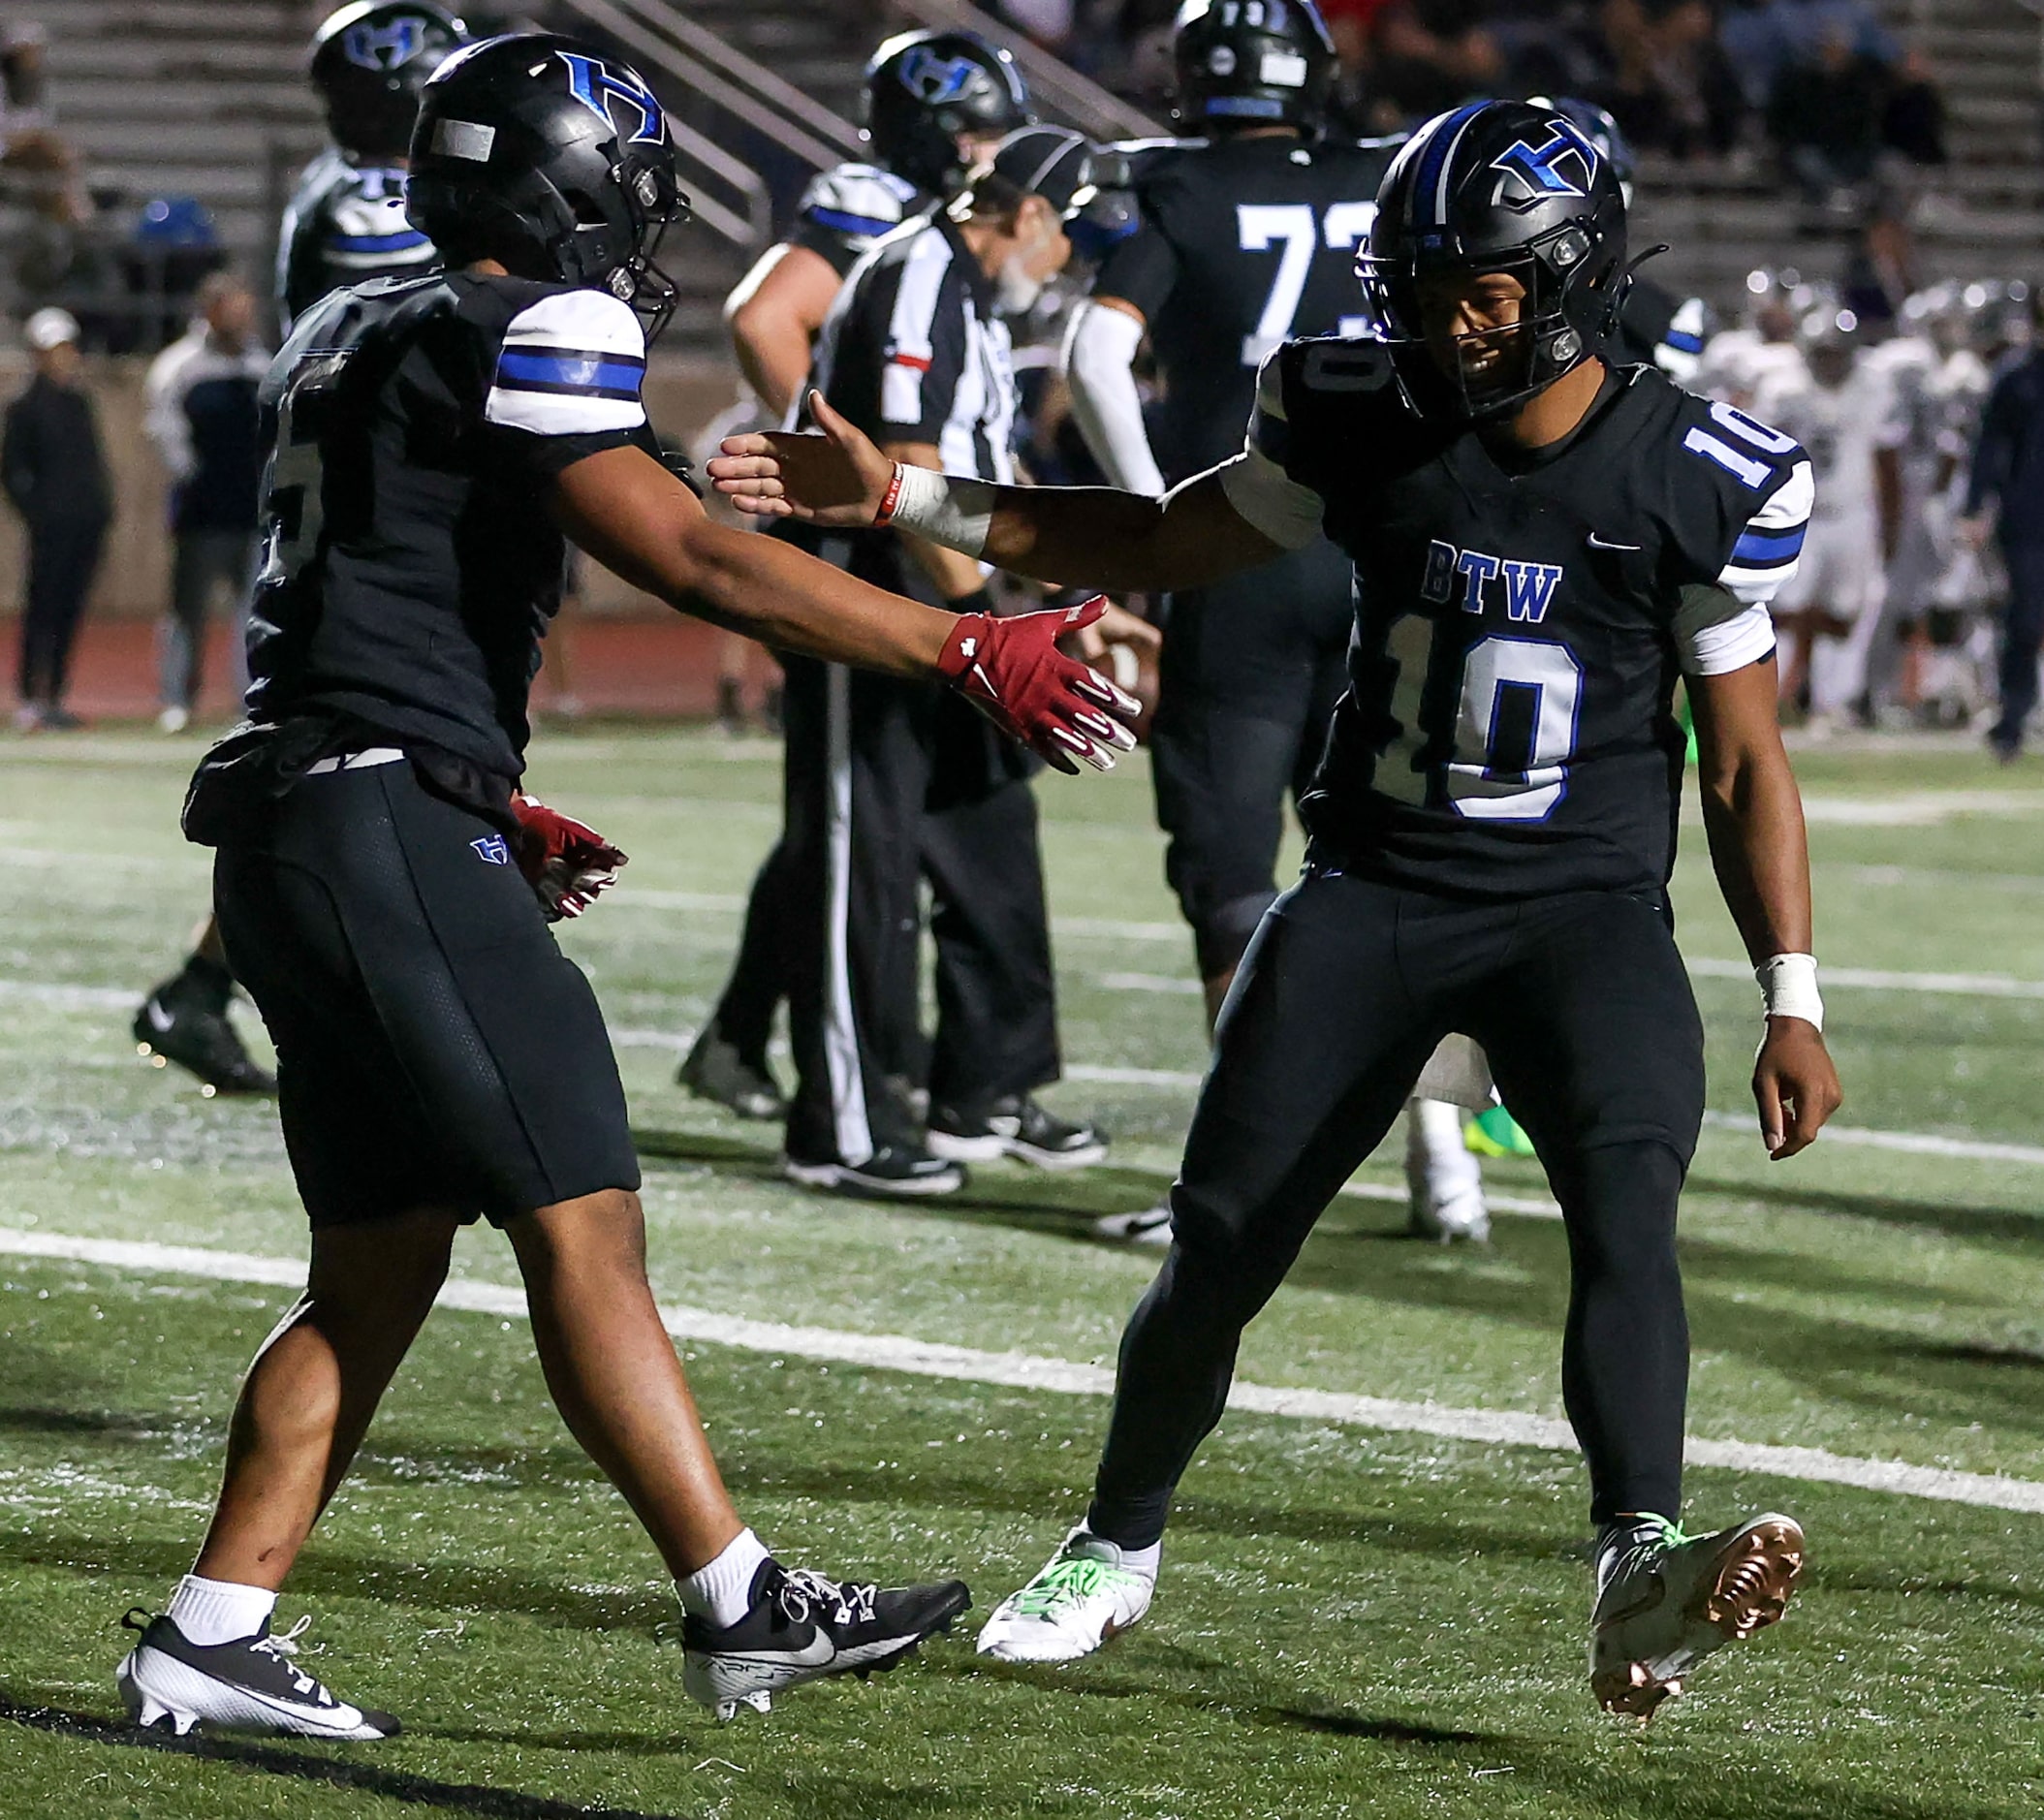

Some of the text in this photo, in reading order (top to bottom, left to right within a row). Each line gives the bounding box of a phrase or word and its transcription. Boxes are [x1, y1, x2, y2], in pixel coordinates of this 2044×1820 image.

[554, 50, 666, 145] H
[1489, 118, 1598, 199] H
[1682, 401, 1801, 492] 10
[1421, 539, 1563, 623] BTW
[1369, 612, 1586, 824] 10
